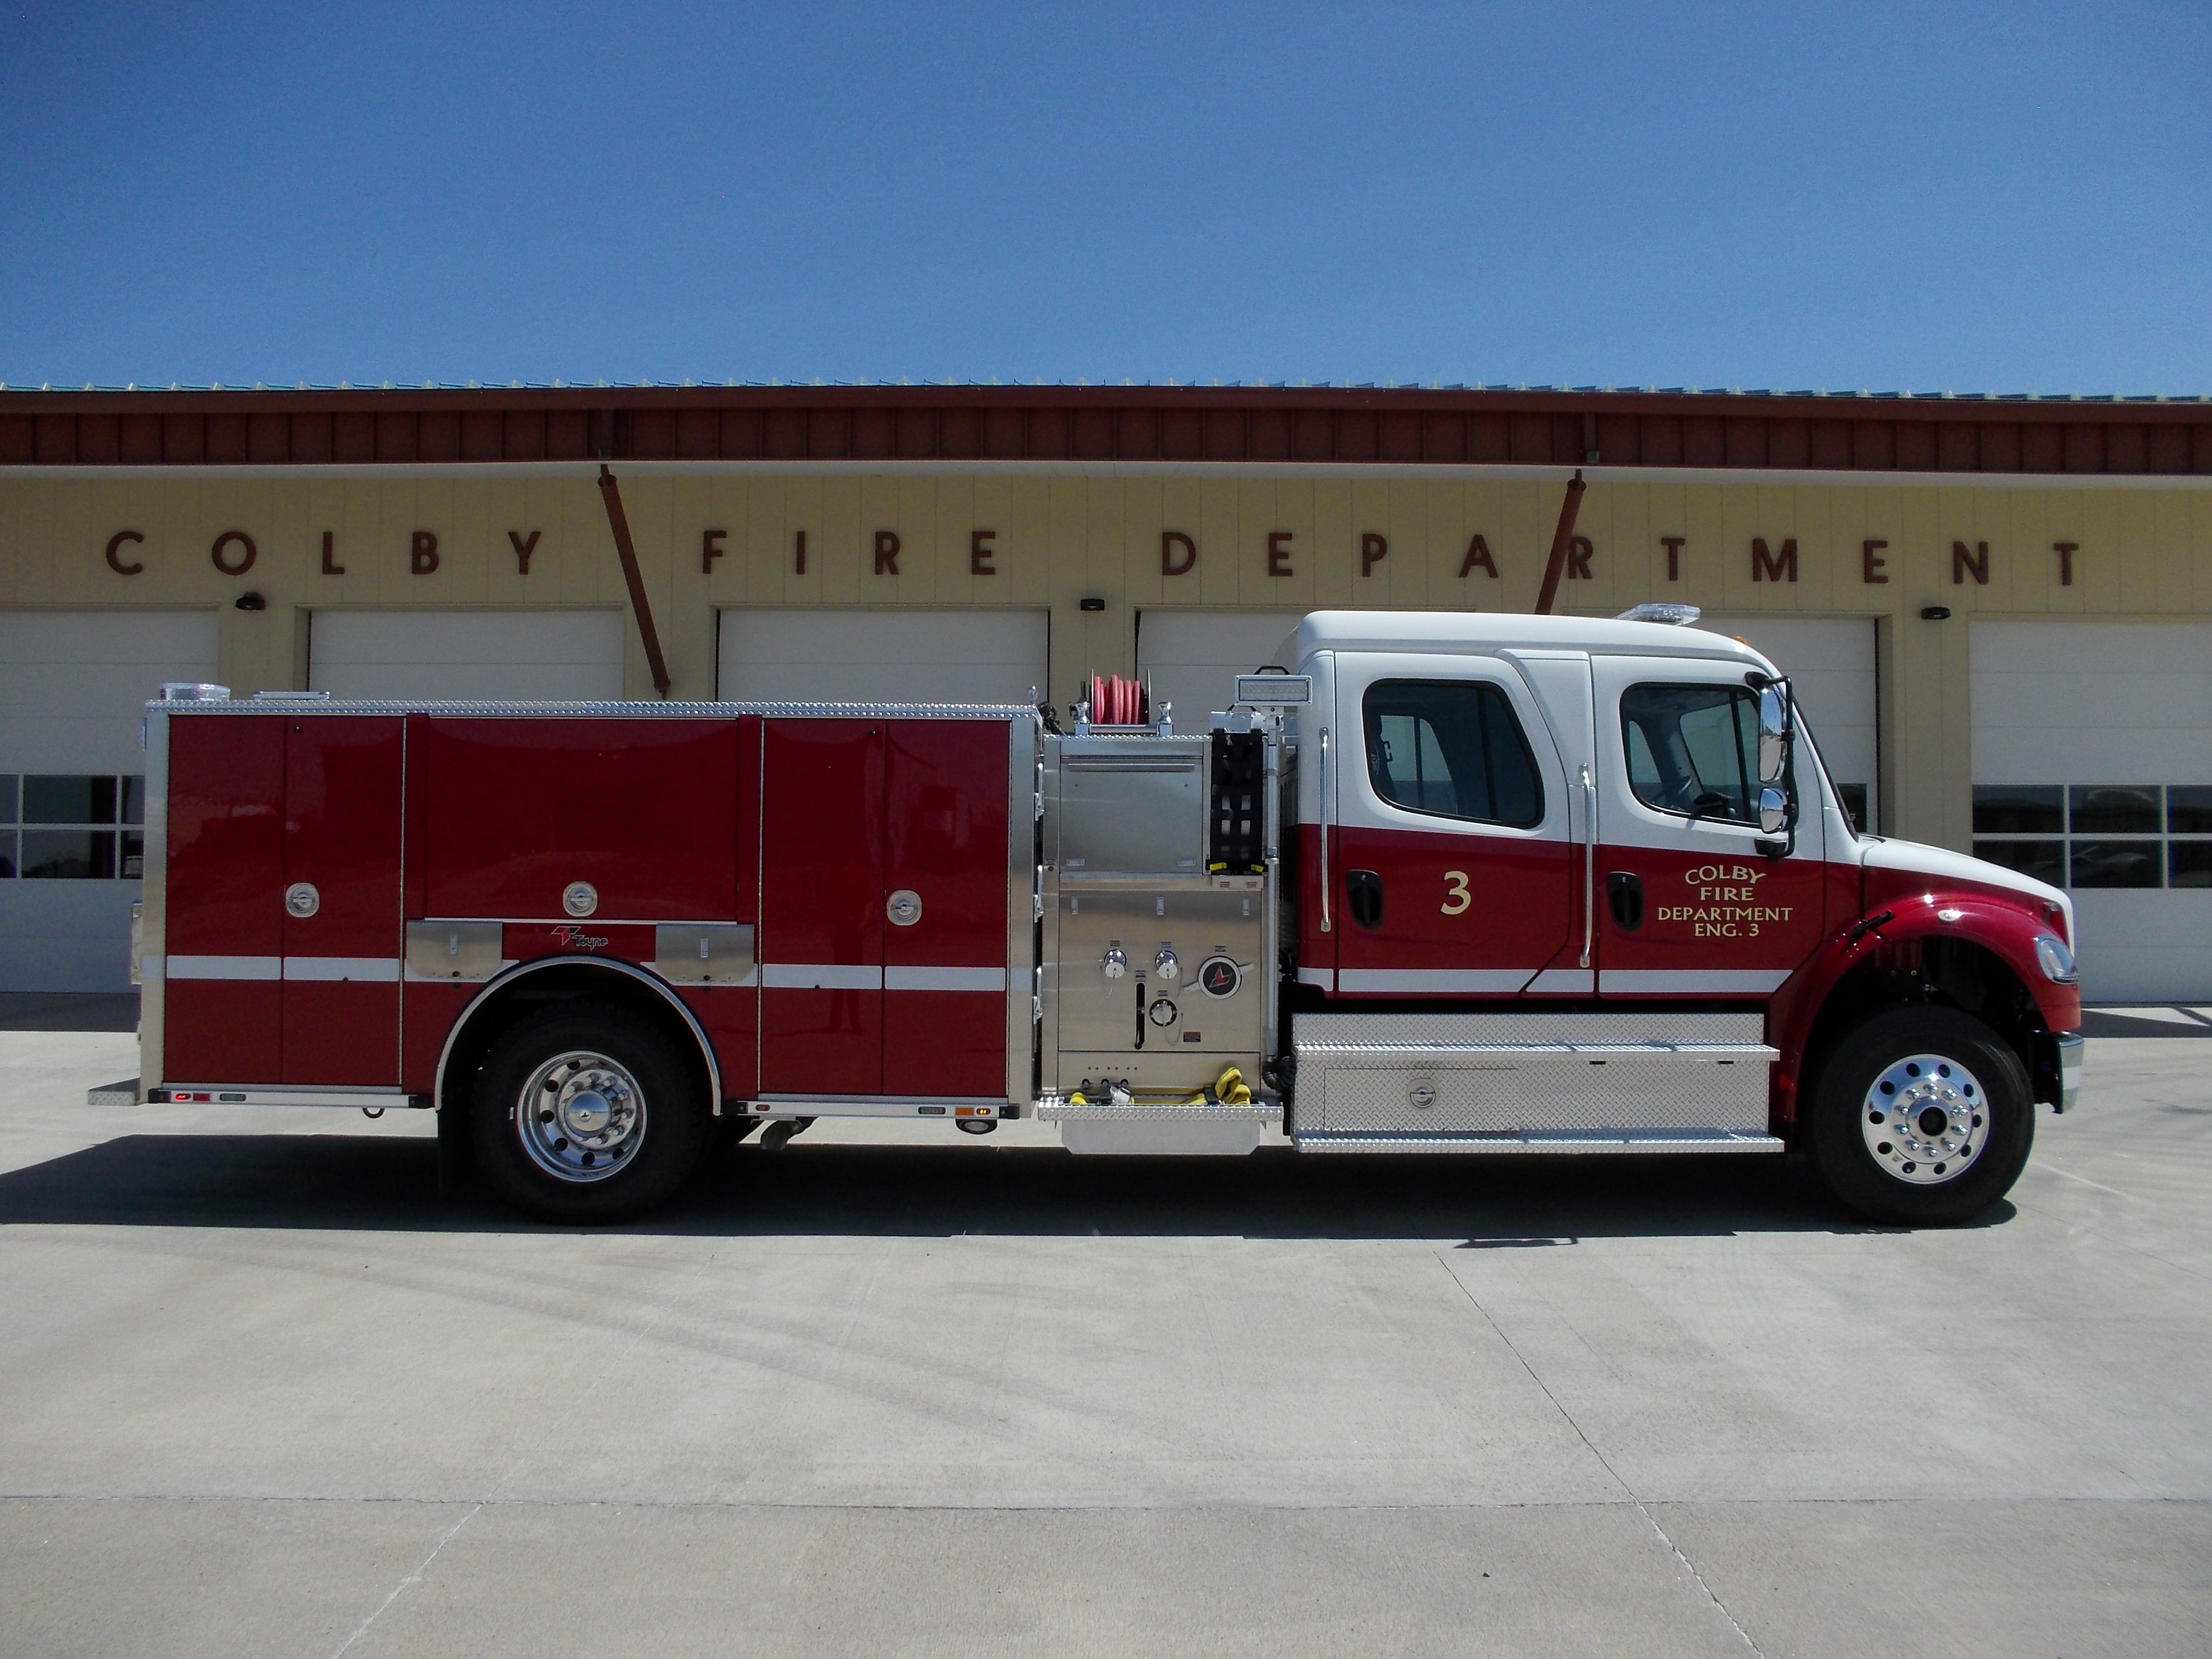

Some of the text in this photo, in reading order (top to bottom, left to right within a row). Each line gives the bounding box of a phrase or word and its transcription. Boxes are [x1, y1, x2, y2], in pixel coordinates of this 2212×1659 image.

[105, 529, 2079, 586] COLBY FIRE DEPARTMENT
[1684, 865, 1768, 886] COLBY
[1439, 870, 1472, 915] 3
[1700, 886, 1755, 901] FIRE
[1657, 907, 1793, 921] DEPARTMENT
[1694, 922, 1760, 937] ENG. 3
[572, 934, 608, 951] Toyne
